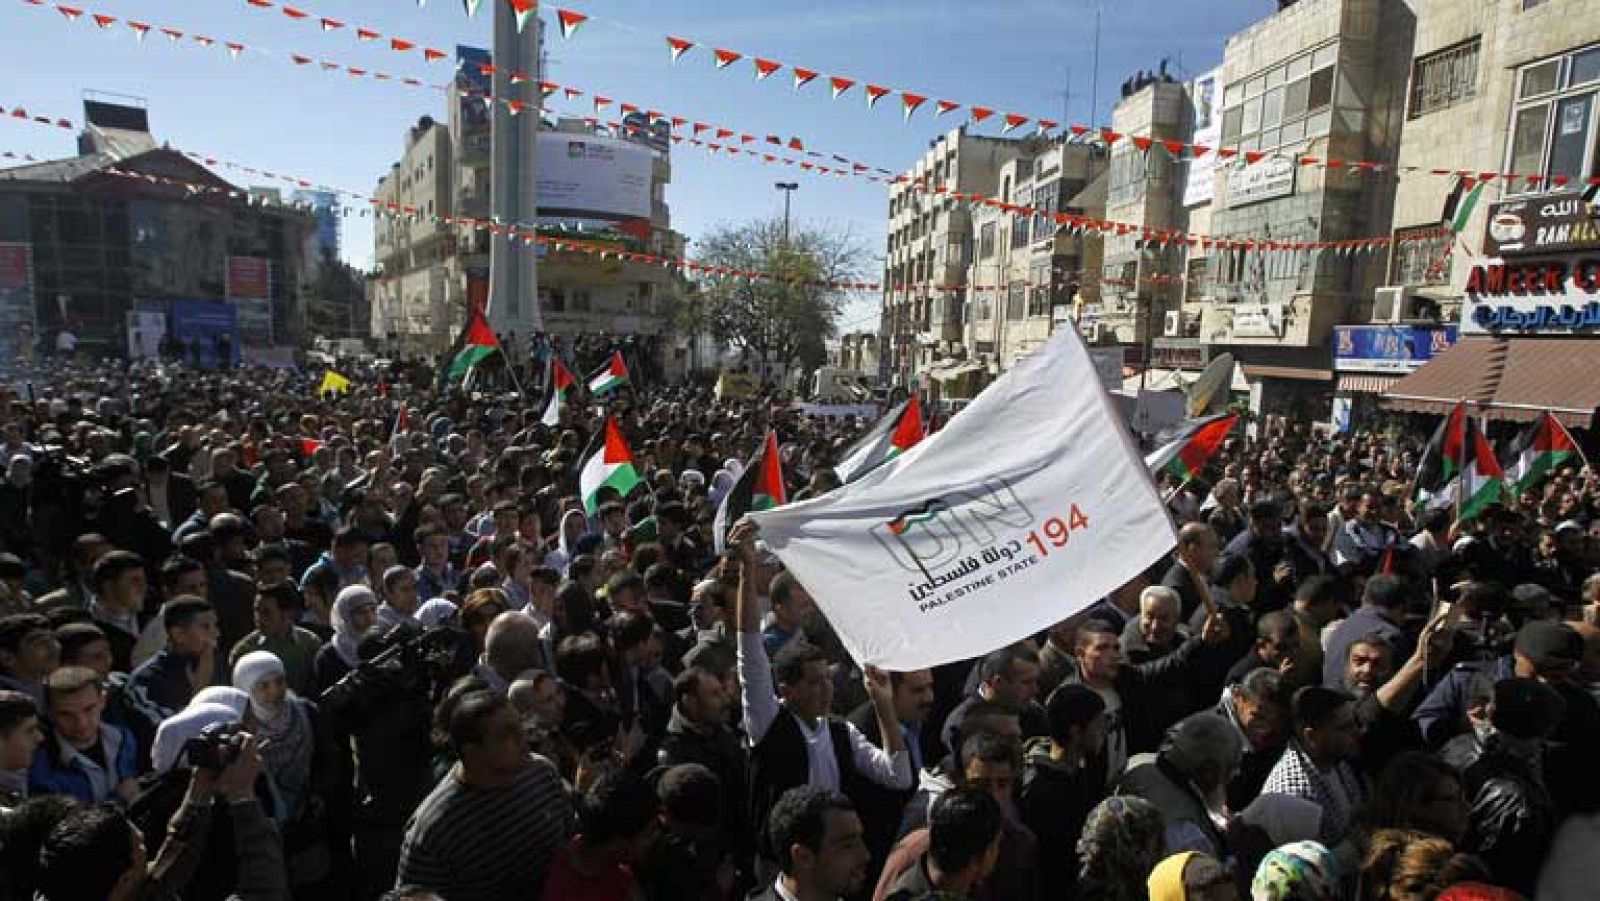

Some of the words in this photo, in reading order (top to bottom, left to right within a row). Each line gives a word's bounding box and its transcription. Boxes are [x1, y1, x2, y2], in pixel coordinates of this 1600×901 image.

[868, 480, 1034, 571] UN
[981, 539, 1022, 564] دولة
[1026, 502, 1089, 557] 194
[908, 556, 981, 601] فلسطين
[918, 574, 995, 612] PALESTINE
[997, 554, 1038, 579] STATE
